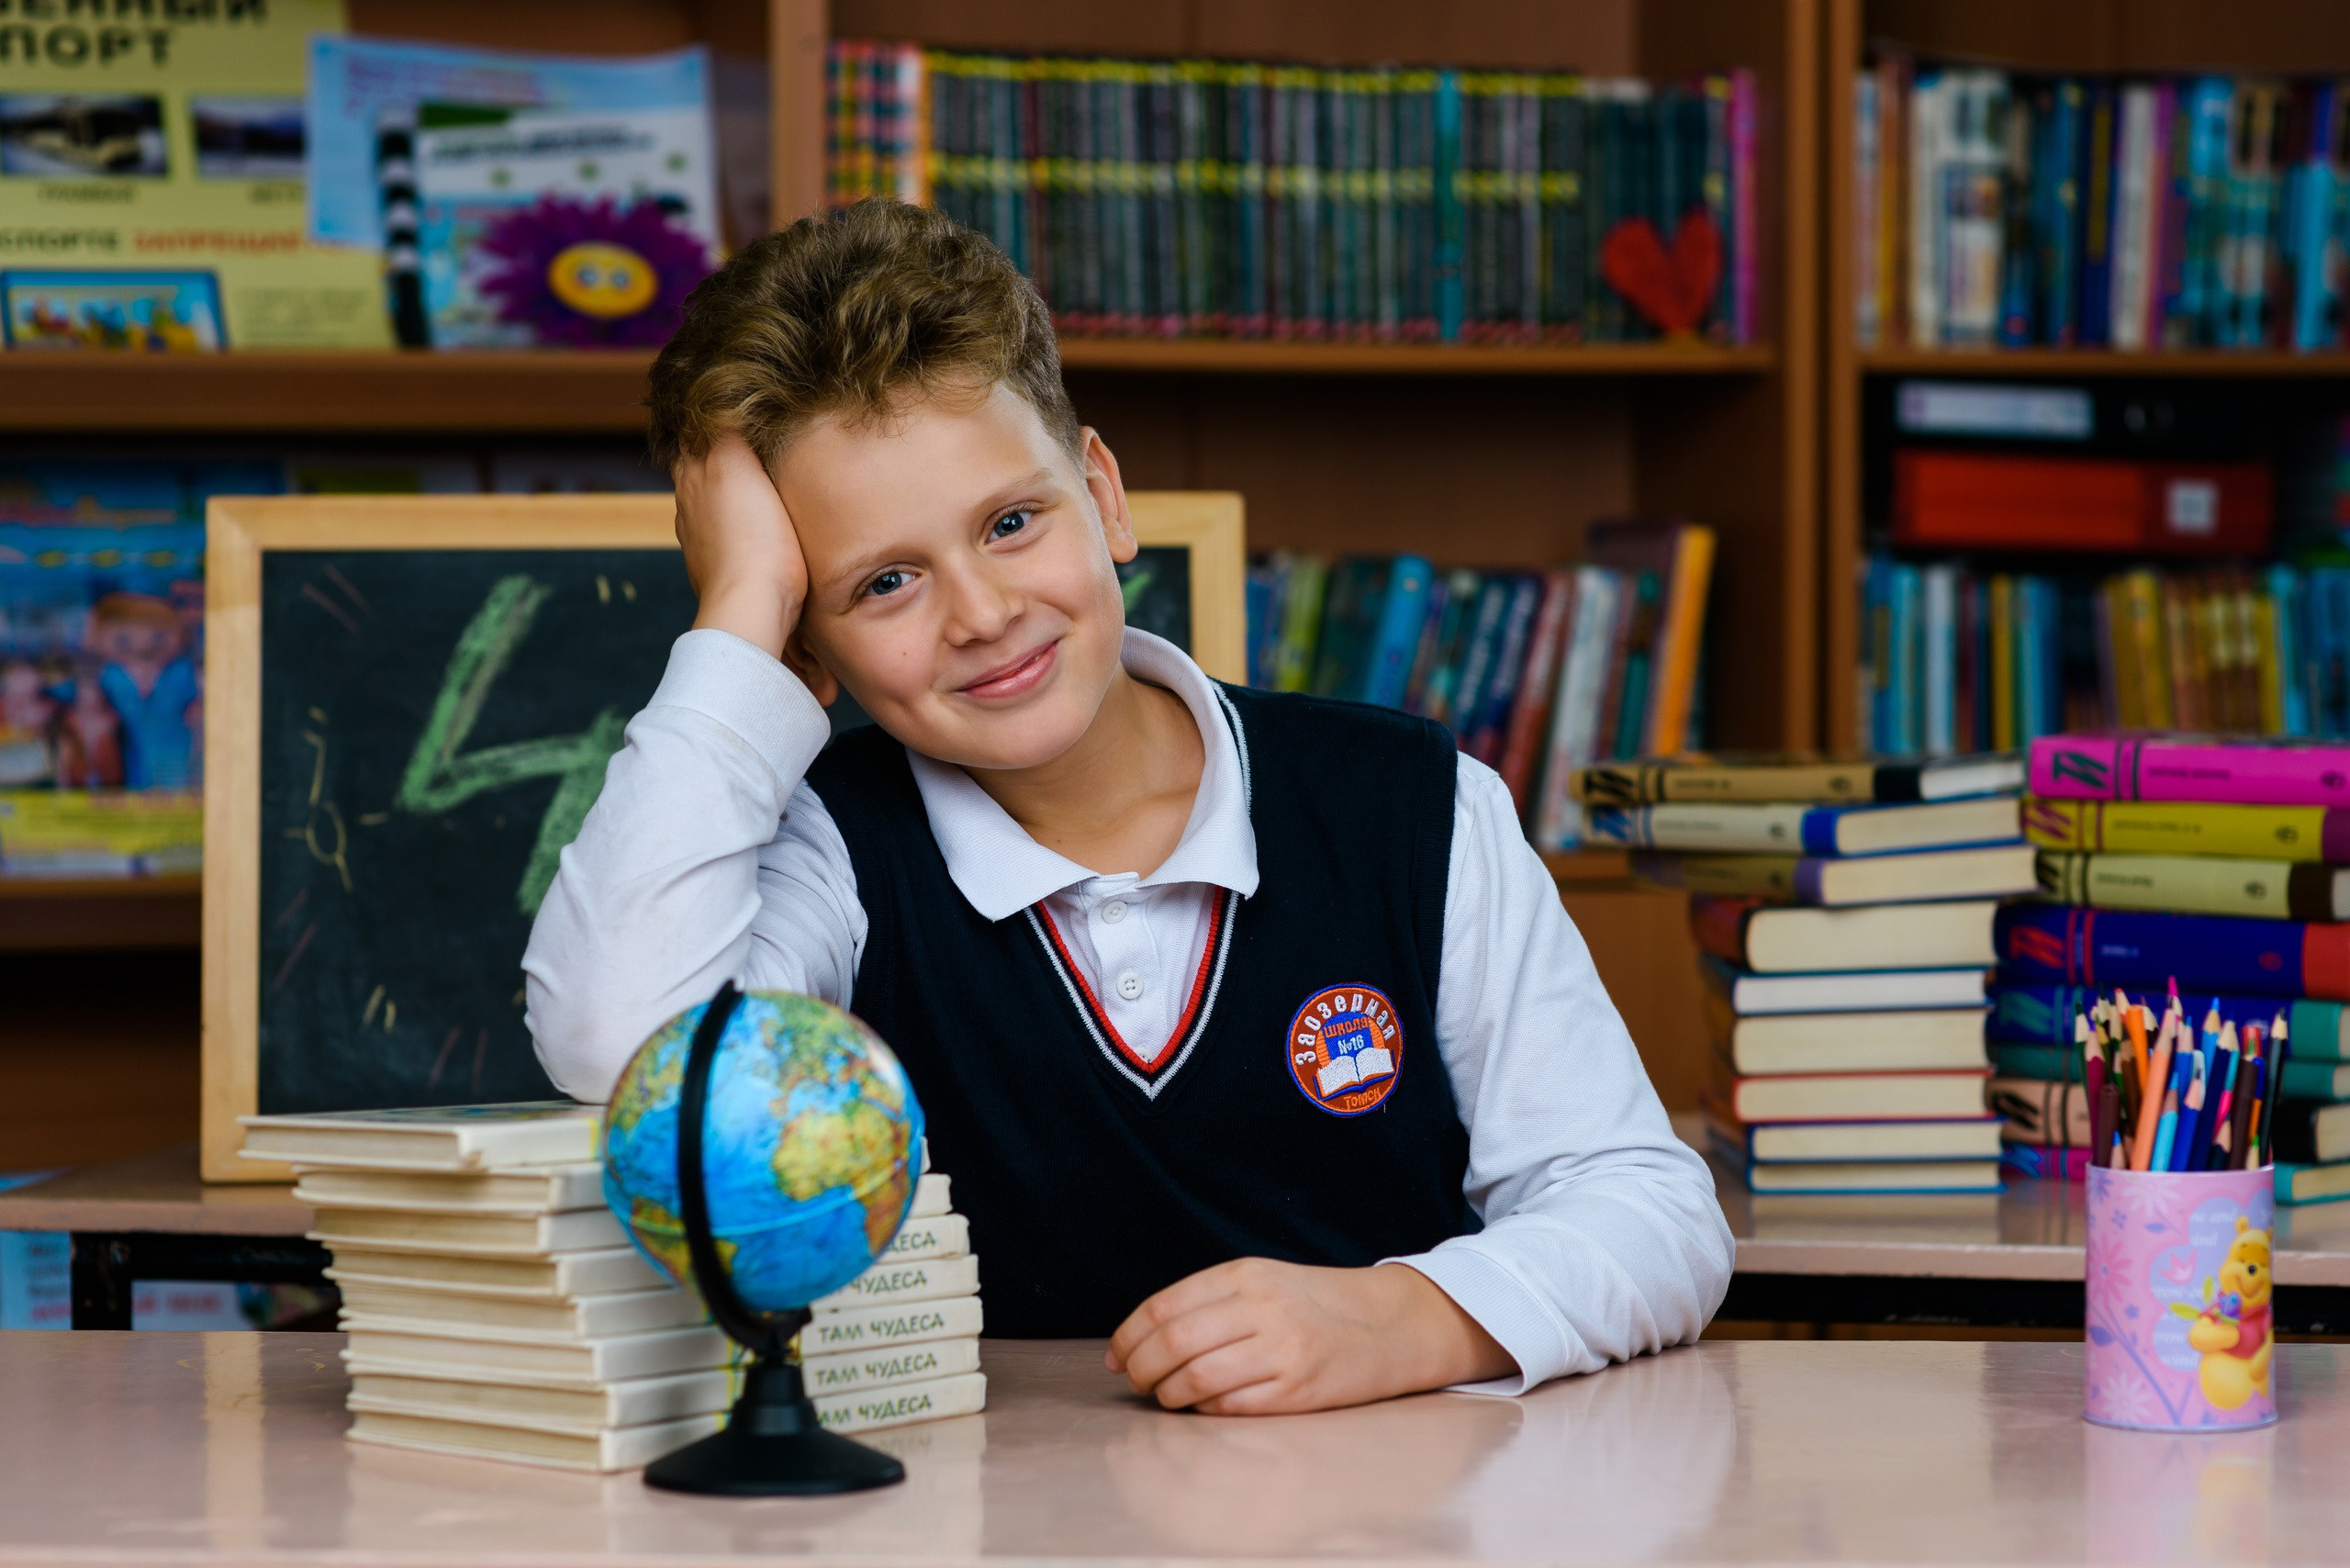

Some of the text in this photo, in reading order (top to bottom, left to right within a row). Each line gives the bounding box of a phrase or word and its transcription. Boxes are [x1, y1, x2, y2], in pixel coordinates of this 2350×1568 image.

[851, 1270, 927, 1296] ЧУДЕСА
[818, 1312, 945, 1343] ТАМ ЧУДЕСА
[814, 1352, 936, 1385] ТАМ ЧУДЕСА
[857, 1394, 932, 1420] ЧУДЕСА
